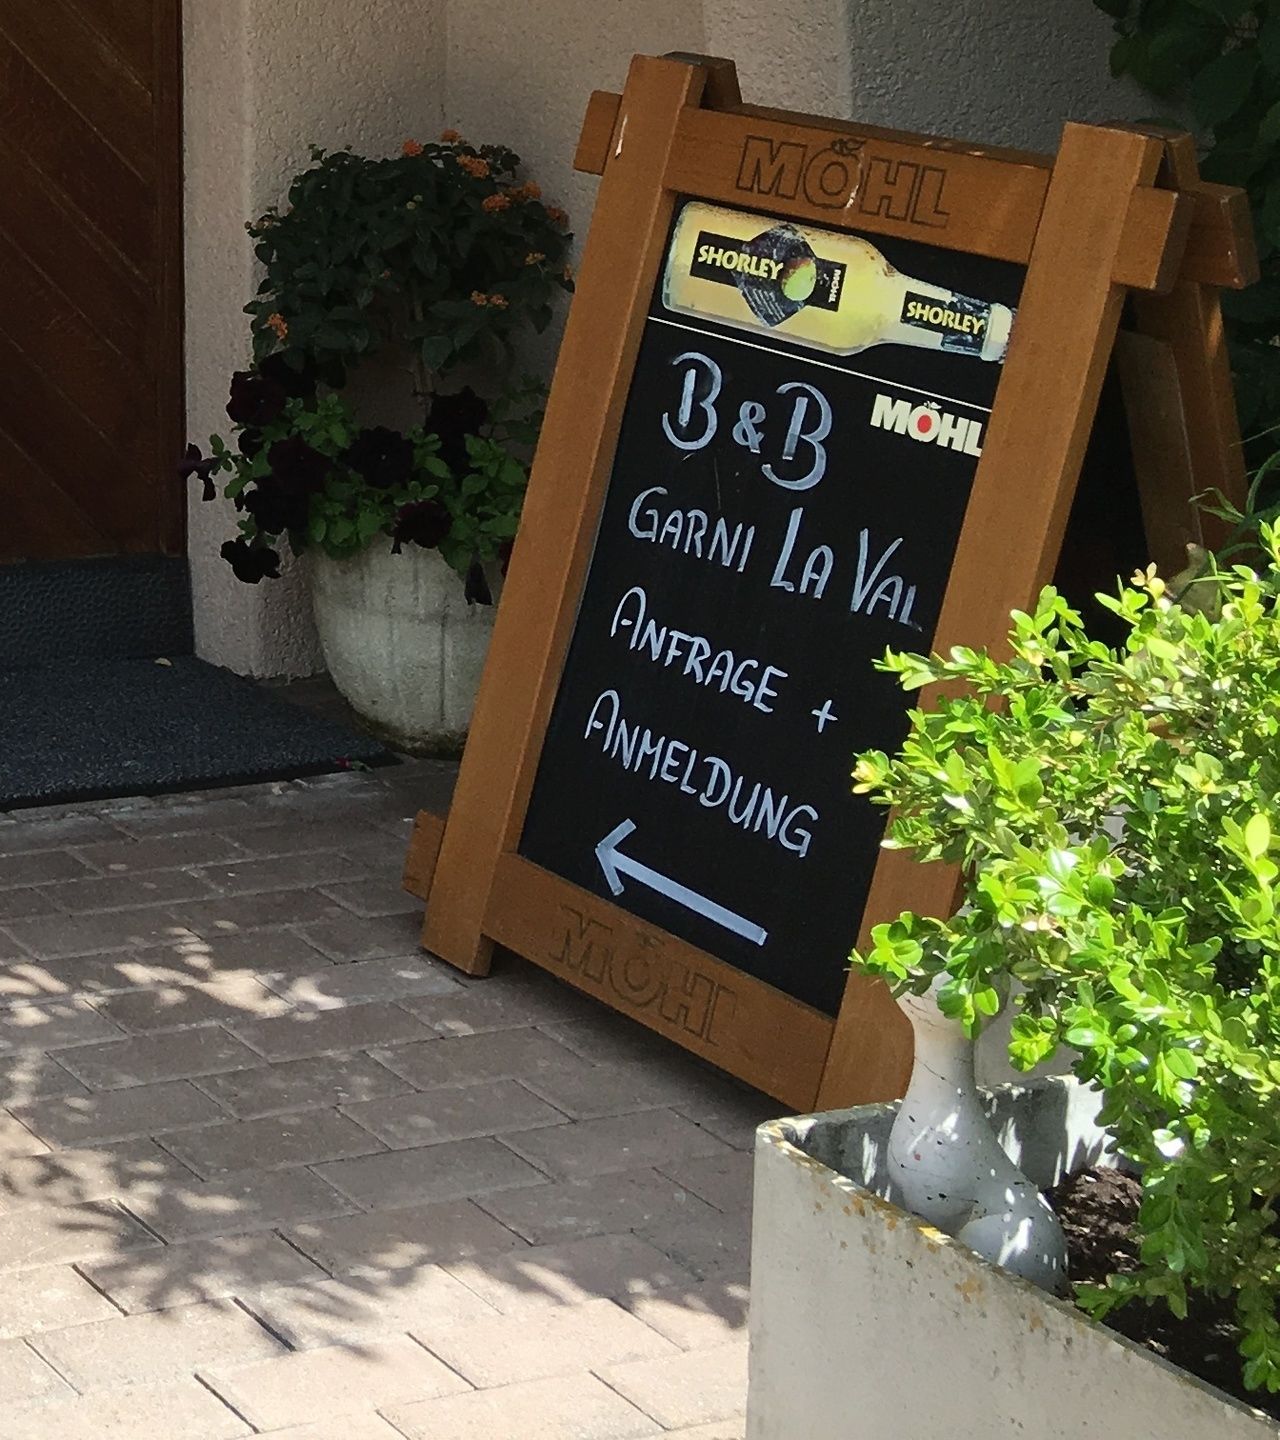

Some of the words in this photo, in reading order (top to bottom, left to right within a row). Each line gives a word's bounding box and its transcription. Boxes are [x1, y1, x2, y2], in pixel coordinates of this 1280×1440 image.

[697, 244, 784, 280] SHORLEY
[906, 301, 985, 335] SHORLEY
[662, 351, 722, 450] B
[732, 400, 766, 453] &
[761, 382, 833, 490] B
[628, 486, 755, 573] GARNI
[610, 586, 788, 712] ANFRAGE
[811, 699, 838, 733] +
[584, 689, 819, 857] ANMELDUNG
